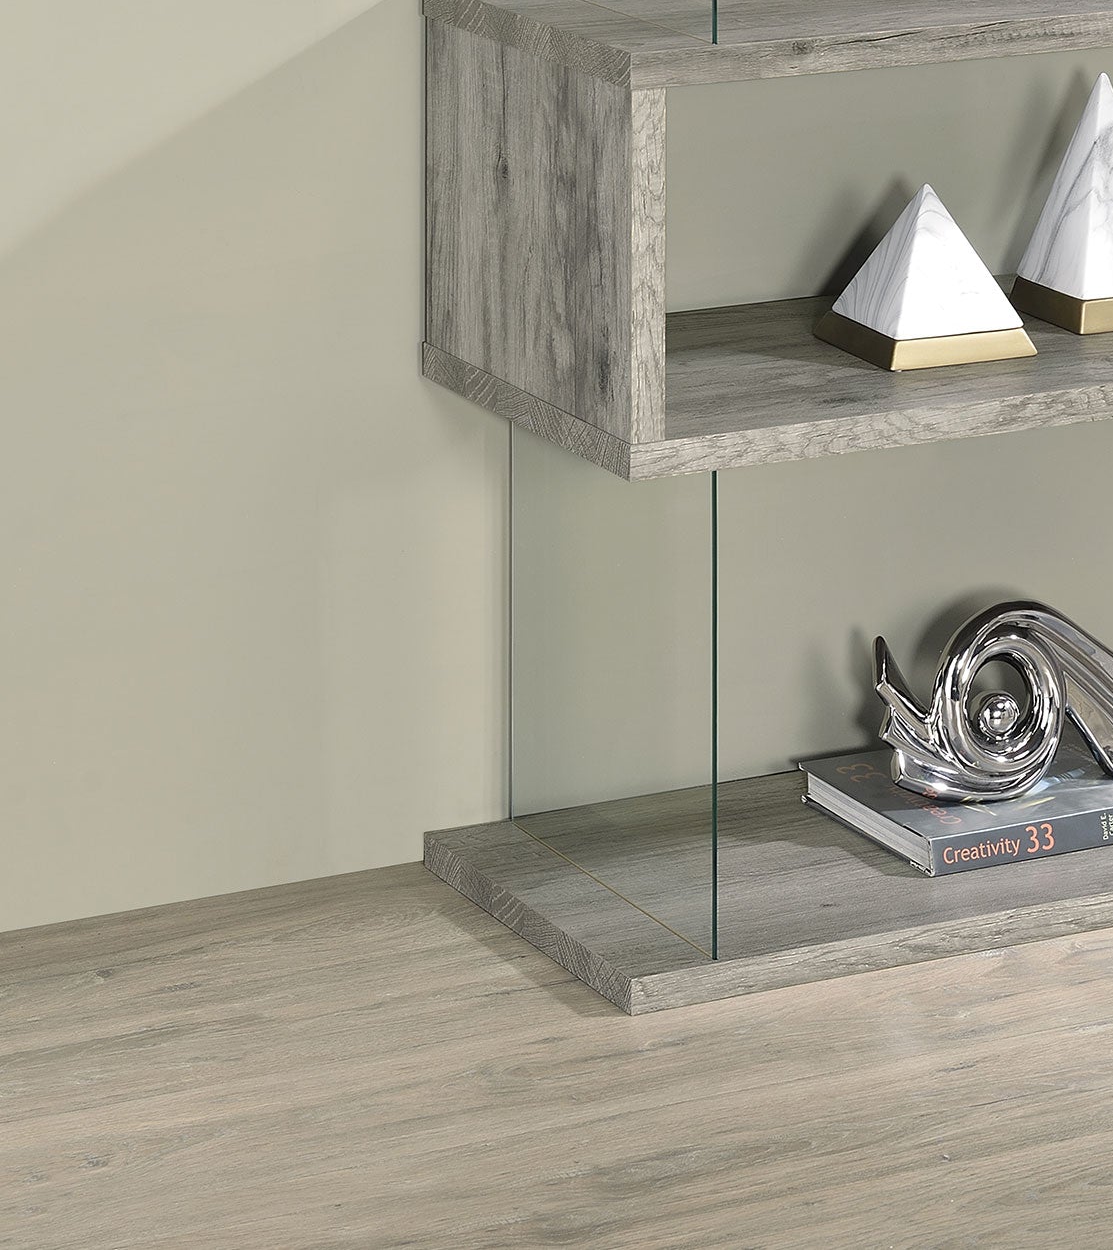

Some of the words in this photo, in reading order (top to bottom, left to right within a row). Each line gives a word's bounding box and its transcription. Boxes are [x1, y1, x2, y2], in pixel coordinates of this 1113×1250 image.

[943, 838, 1021, 865] Creativity
[1025, 823, 1056, 854] 33
[1101, 820, 1109, 840] David
